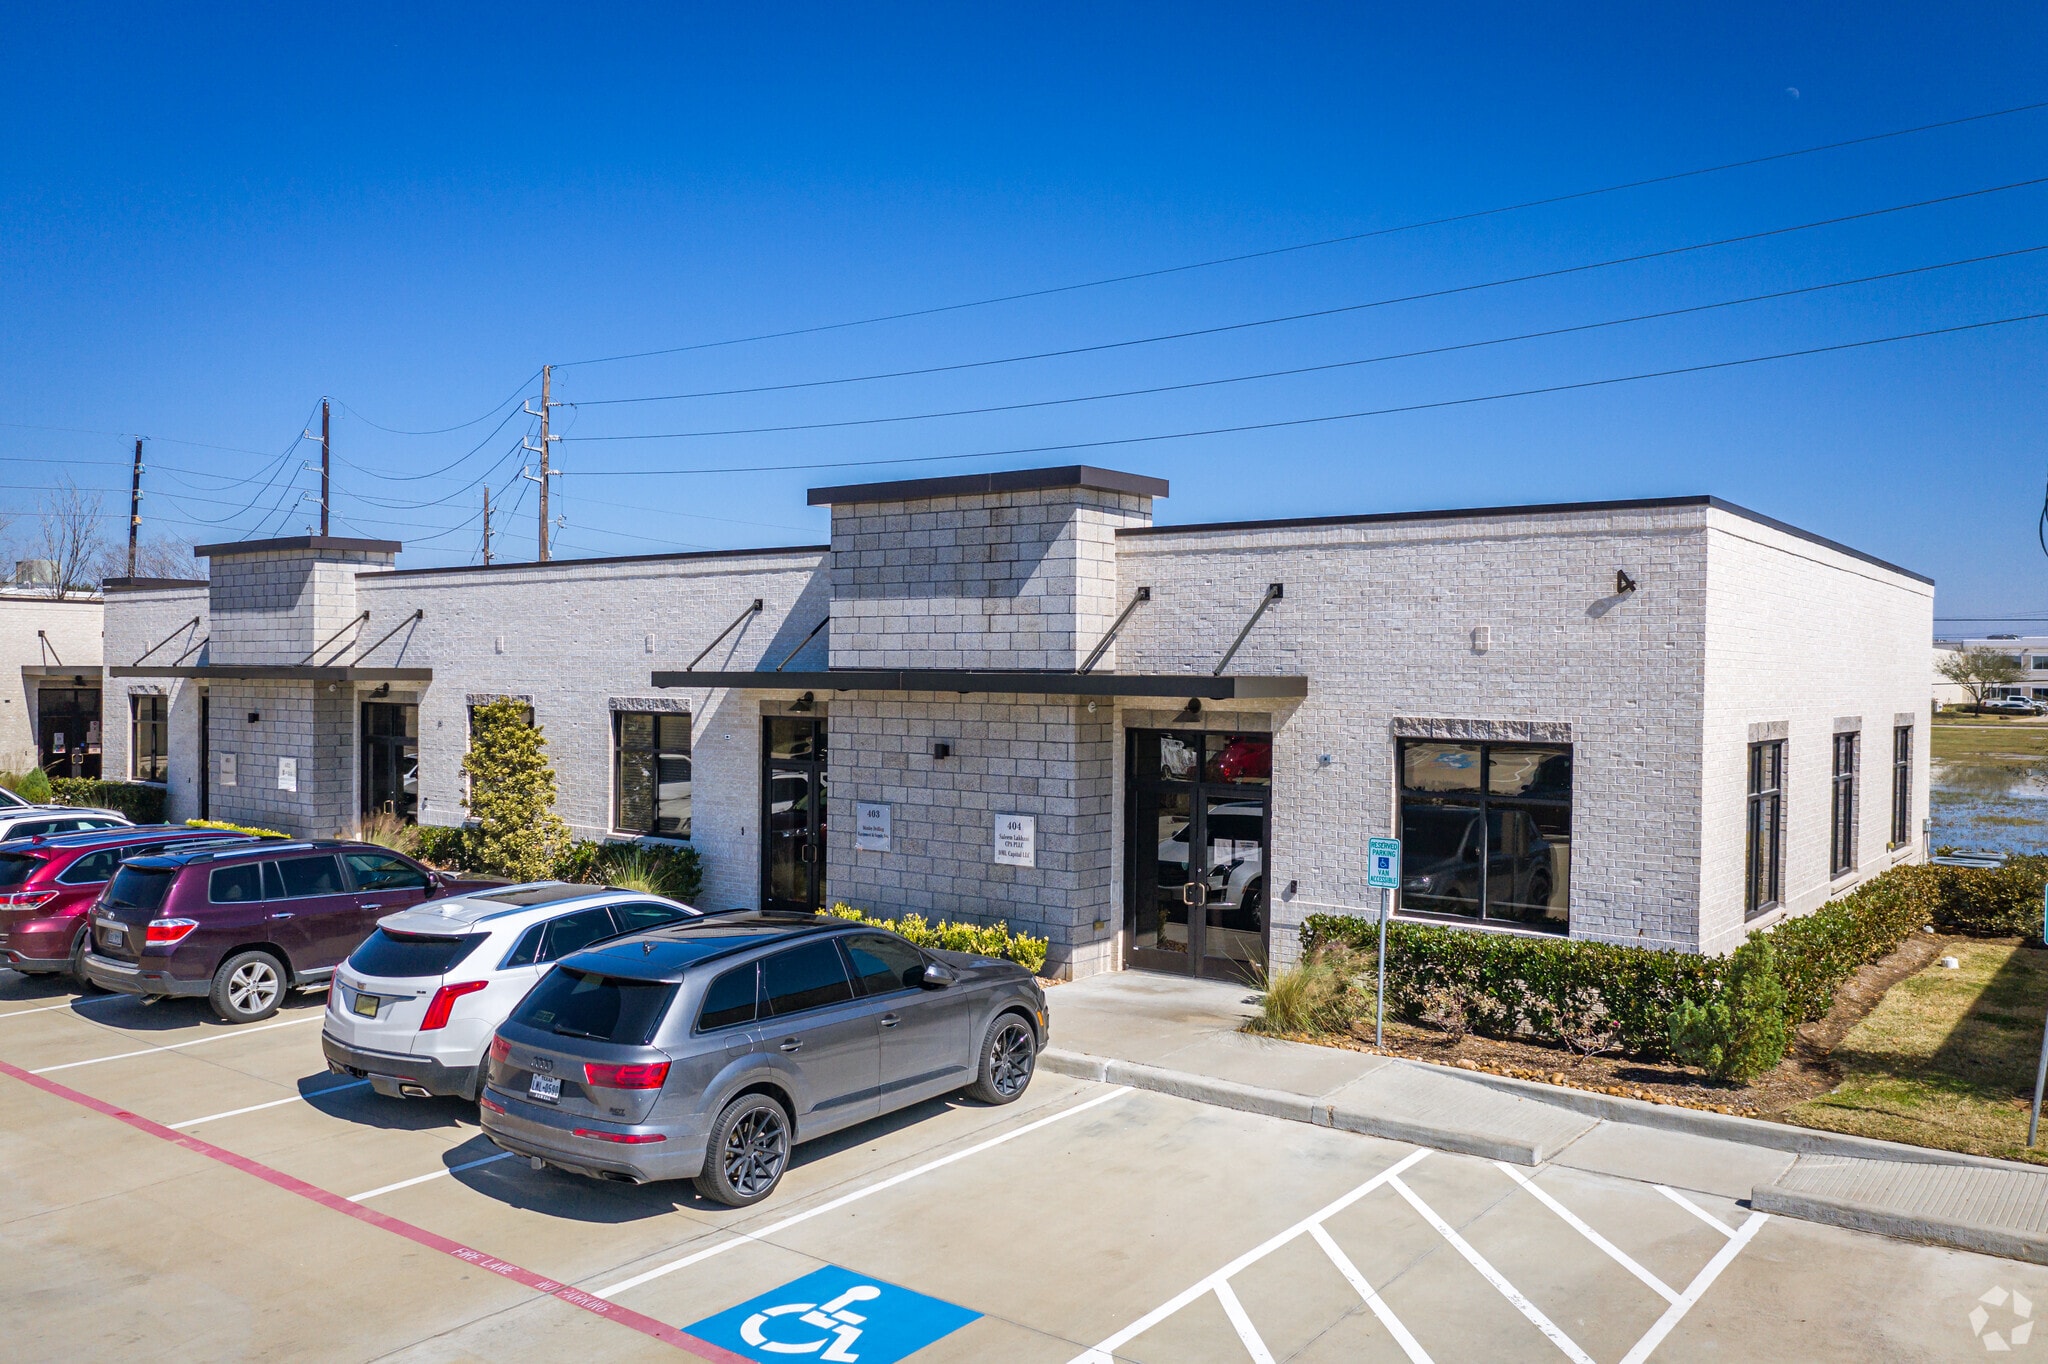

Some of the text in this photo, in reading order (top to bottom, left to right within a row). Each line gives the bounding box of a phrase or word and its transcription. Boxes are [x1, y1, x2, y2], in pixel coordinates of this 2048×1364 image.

[1617, 569, 1637, 593] 4
[867, 810, 880, 818] 403
[1007, 821, 1021, 830] 404
[1371, 842, 1398, 850] RESERVED
[1372, 849, 1396, 857] PARKING
[1371, 876, 1397, 884] ACCESSIBLE
[451, 1248, 609, 1313] FIRE LANE NO PARKING
